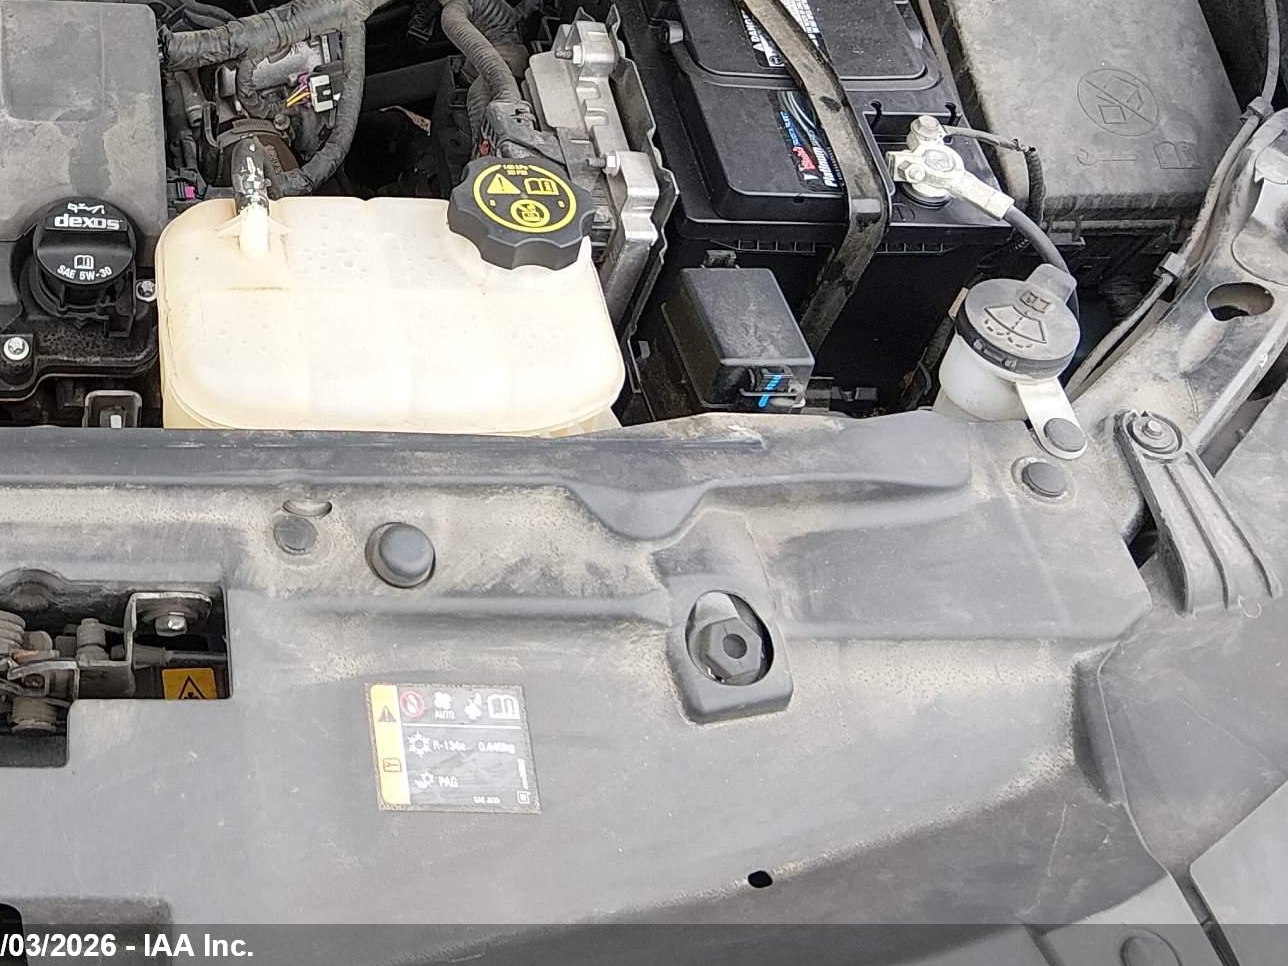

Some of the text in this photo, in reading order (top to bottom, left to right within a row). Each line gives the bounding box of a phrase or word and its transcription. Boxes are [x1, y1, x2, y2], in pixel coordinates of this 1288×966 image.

[813, 146, 838, 187] Platinum
[54, 213, 120, 230] dexos
[57, 264, 112, 281] SAE 5W-30
[435, 709, 456, 719] AUTO
[438, 776, 458, 787] PAG
